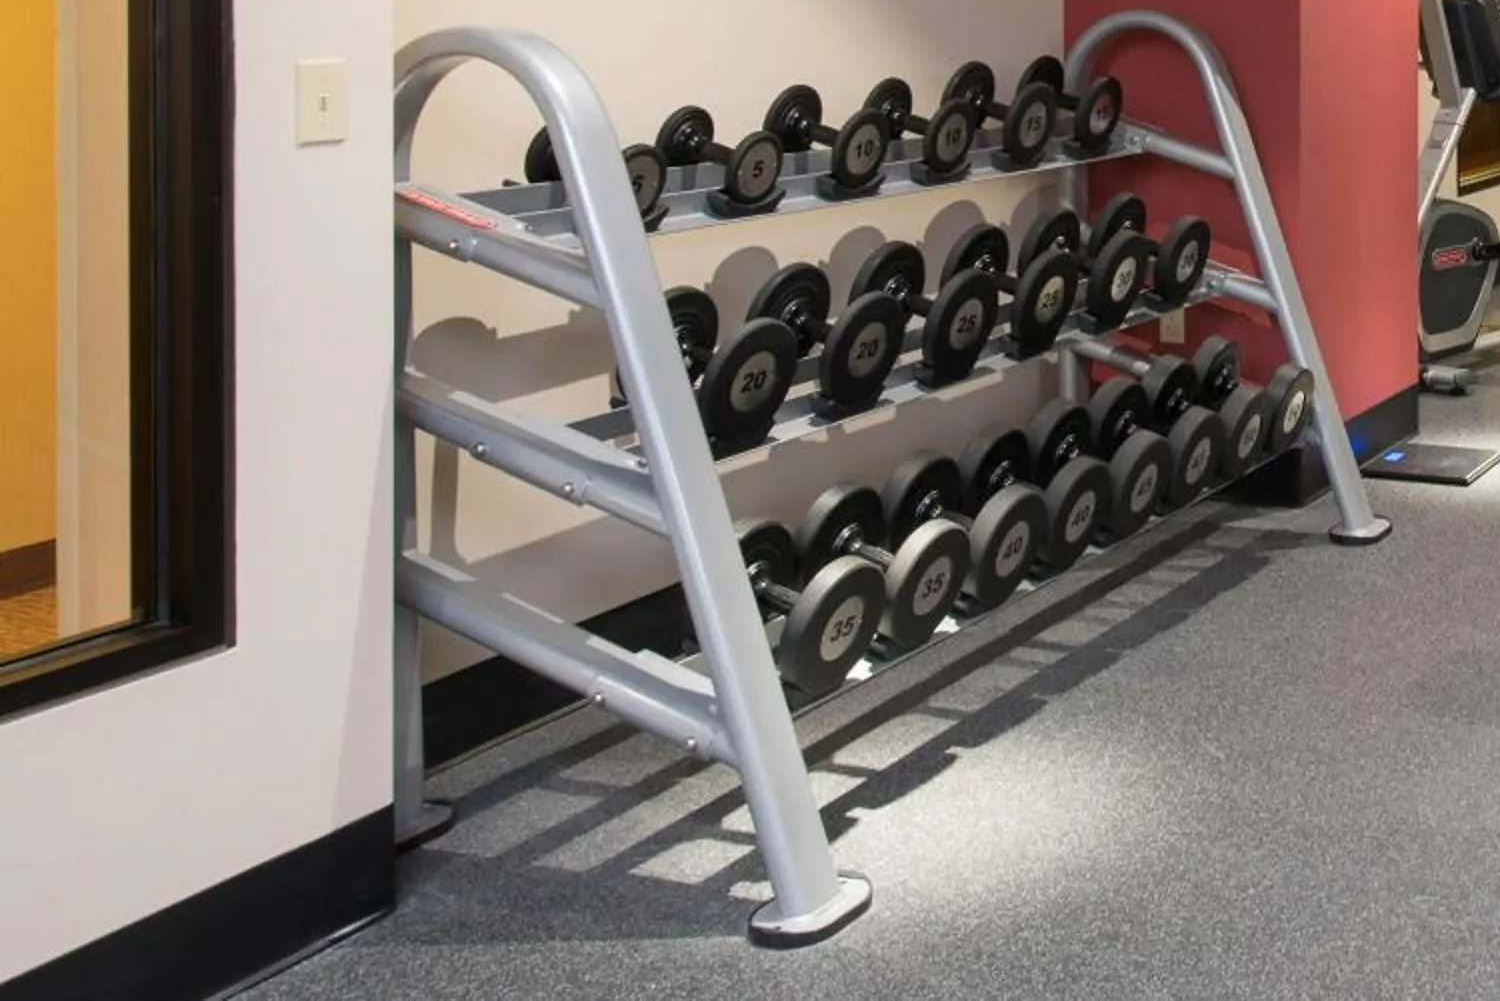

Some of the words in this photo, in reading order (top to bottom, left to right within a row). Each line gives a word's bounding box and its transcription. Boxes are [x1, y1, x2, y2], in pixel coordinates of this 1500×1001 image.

[1024, 115, 1042, 131] 15
[944, 129, 962, 145] 10
[855, 142, 874, 160] 10
[751, 159, 766, 179] 5
[956, 315, 977, 334] 25
[856, 339, 879, 360] 20
[740, 369, 768, 394] 20
[1002, 535, 1024, 560] 40
[922, 571, 947, 598] 35
[830, 614, 857, 642] 35
